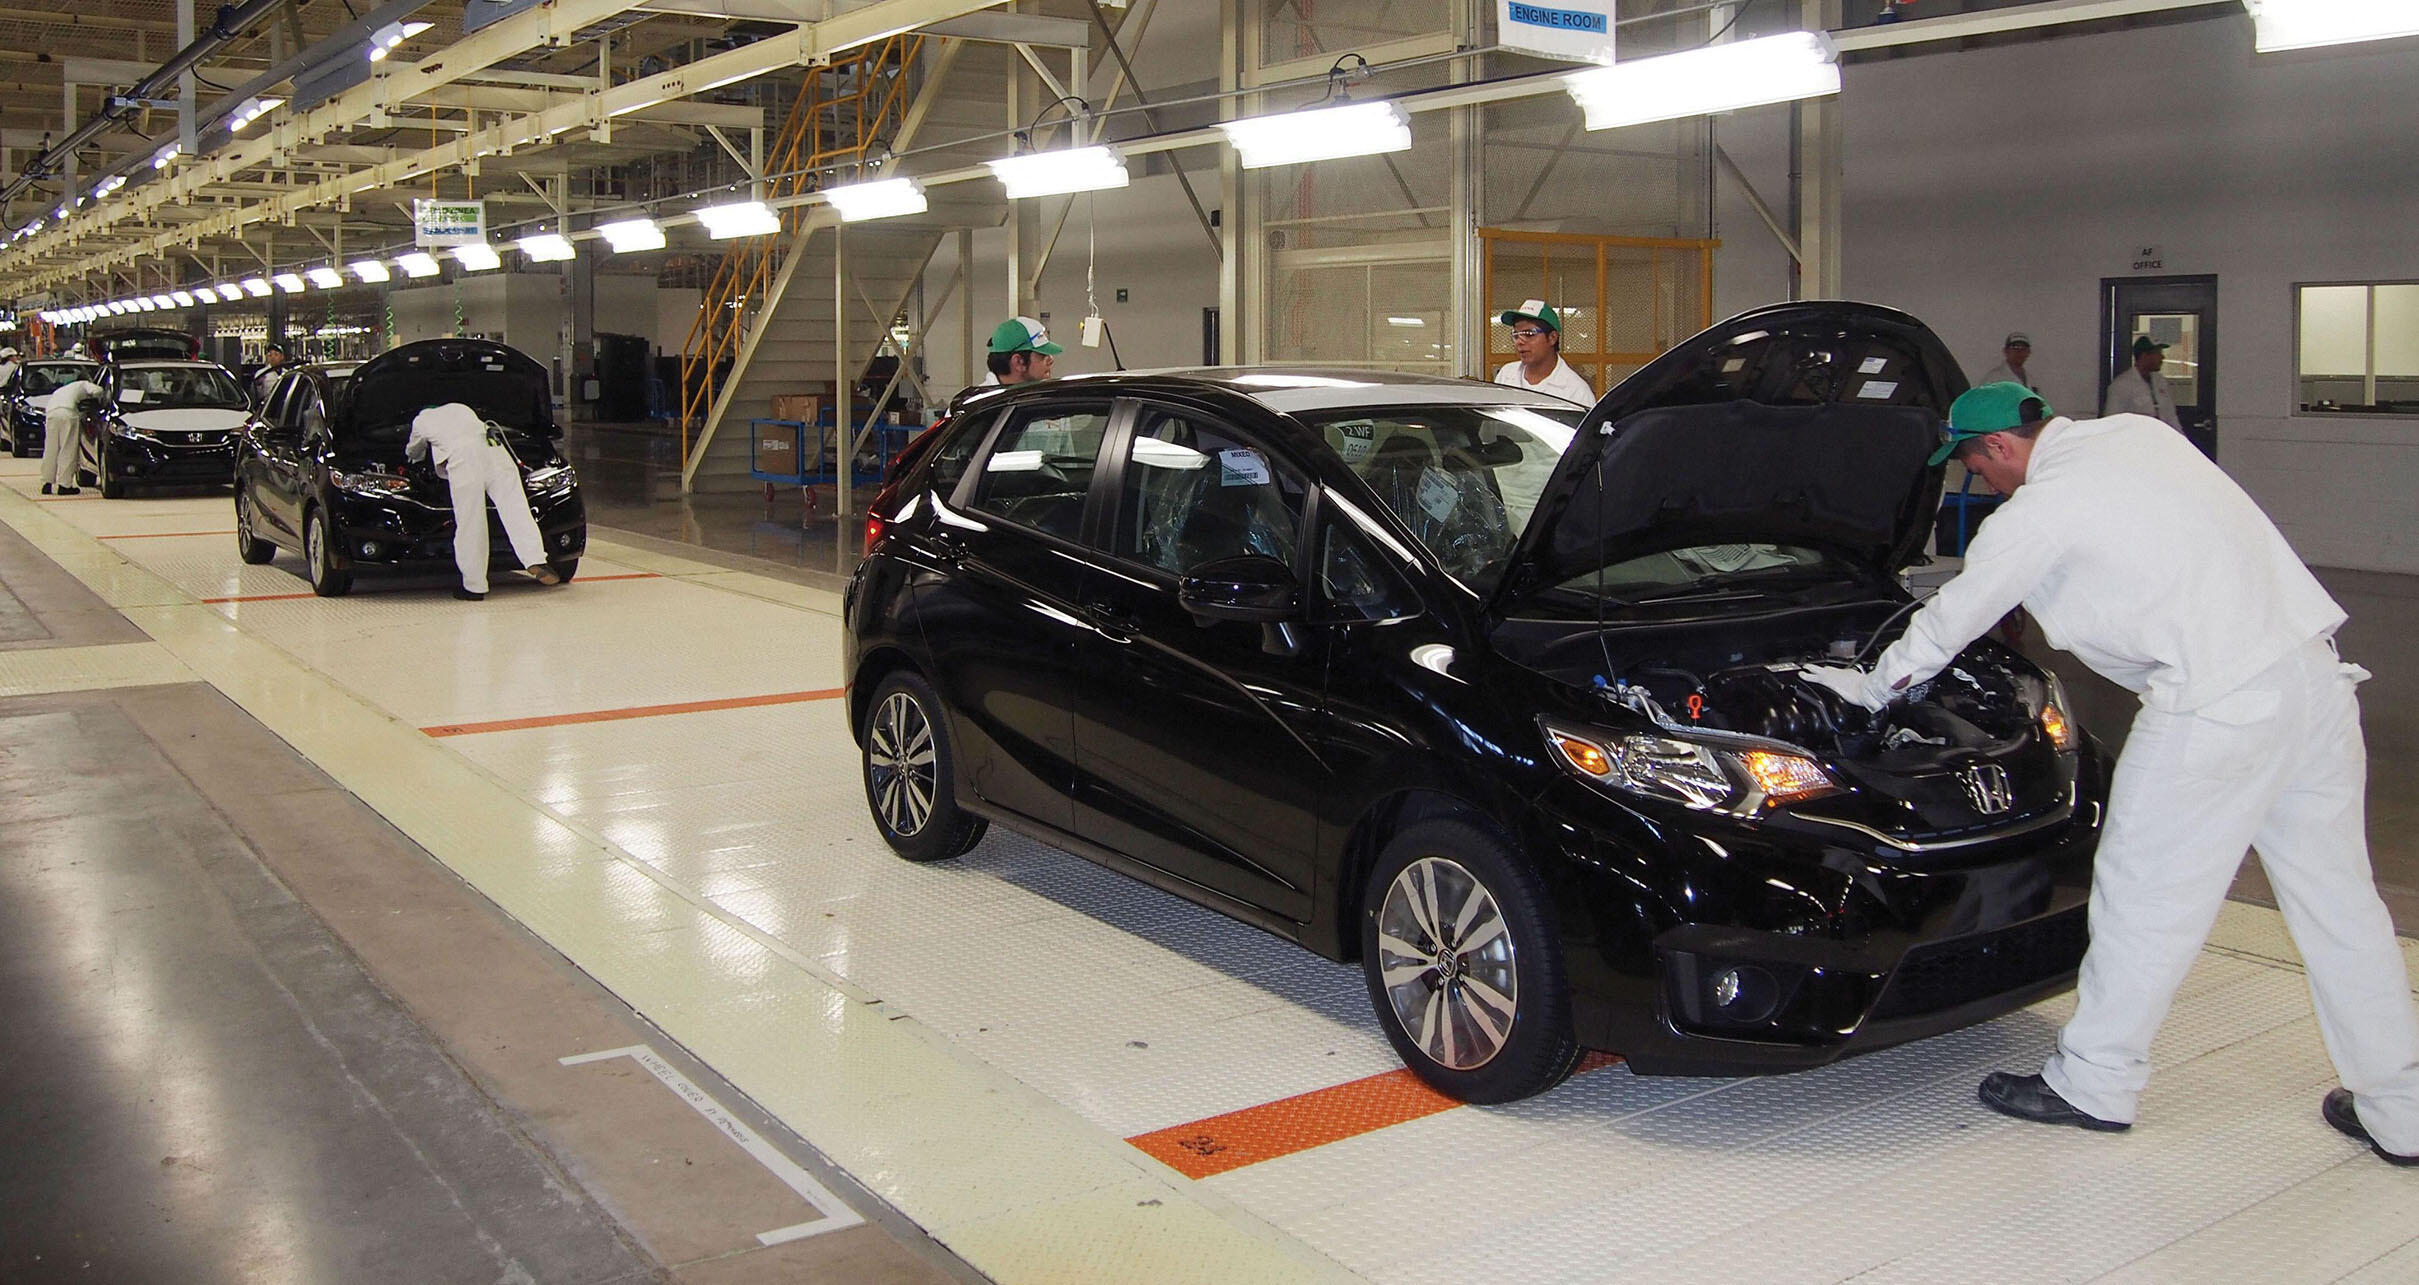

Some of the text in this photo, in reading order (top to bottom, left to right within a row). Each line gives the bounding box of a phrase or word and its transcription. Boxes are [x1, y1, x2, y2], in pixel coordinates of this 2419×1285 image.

[1515, 5, 1601, 29] ENGINE ROOM
[2141, 247, 2153, 256] AF
[2132, 259, 2163, 270] OFFICE
